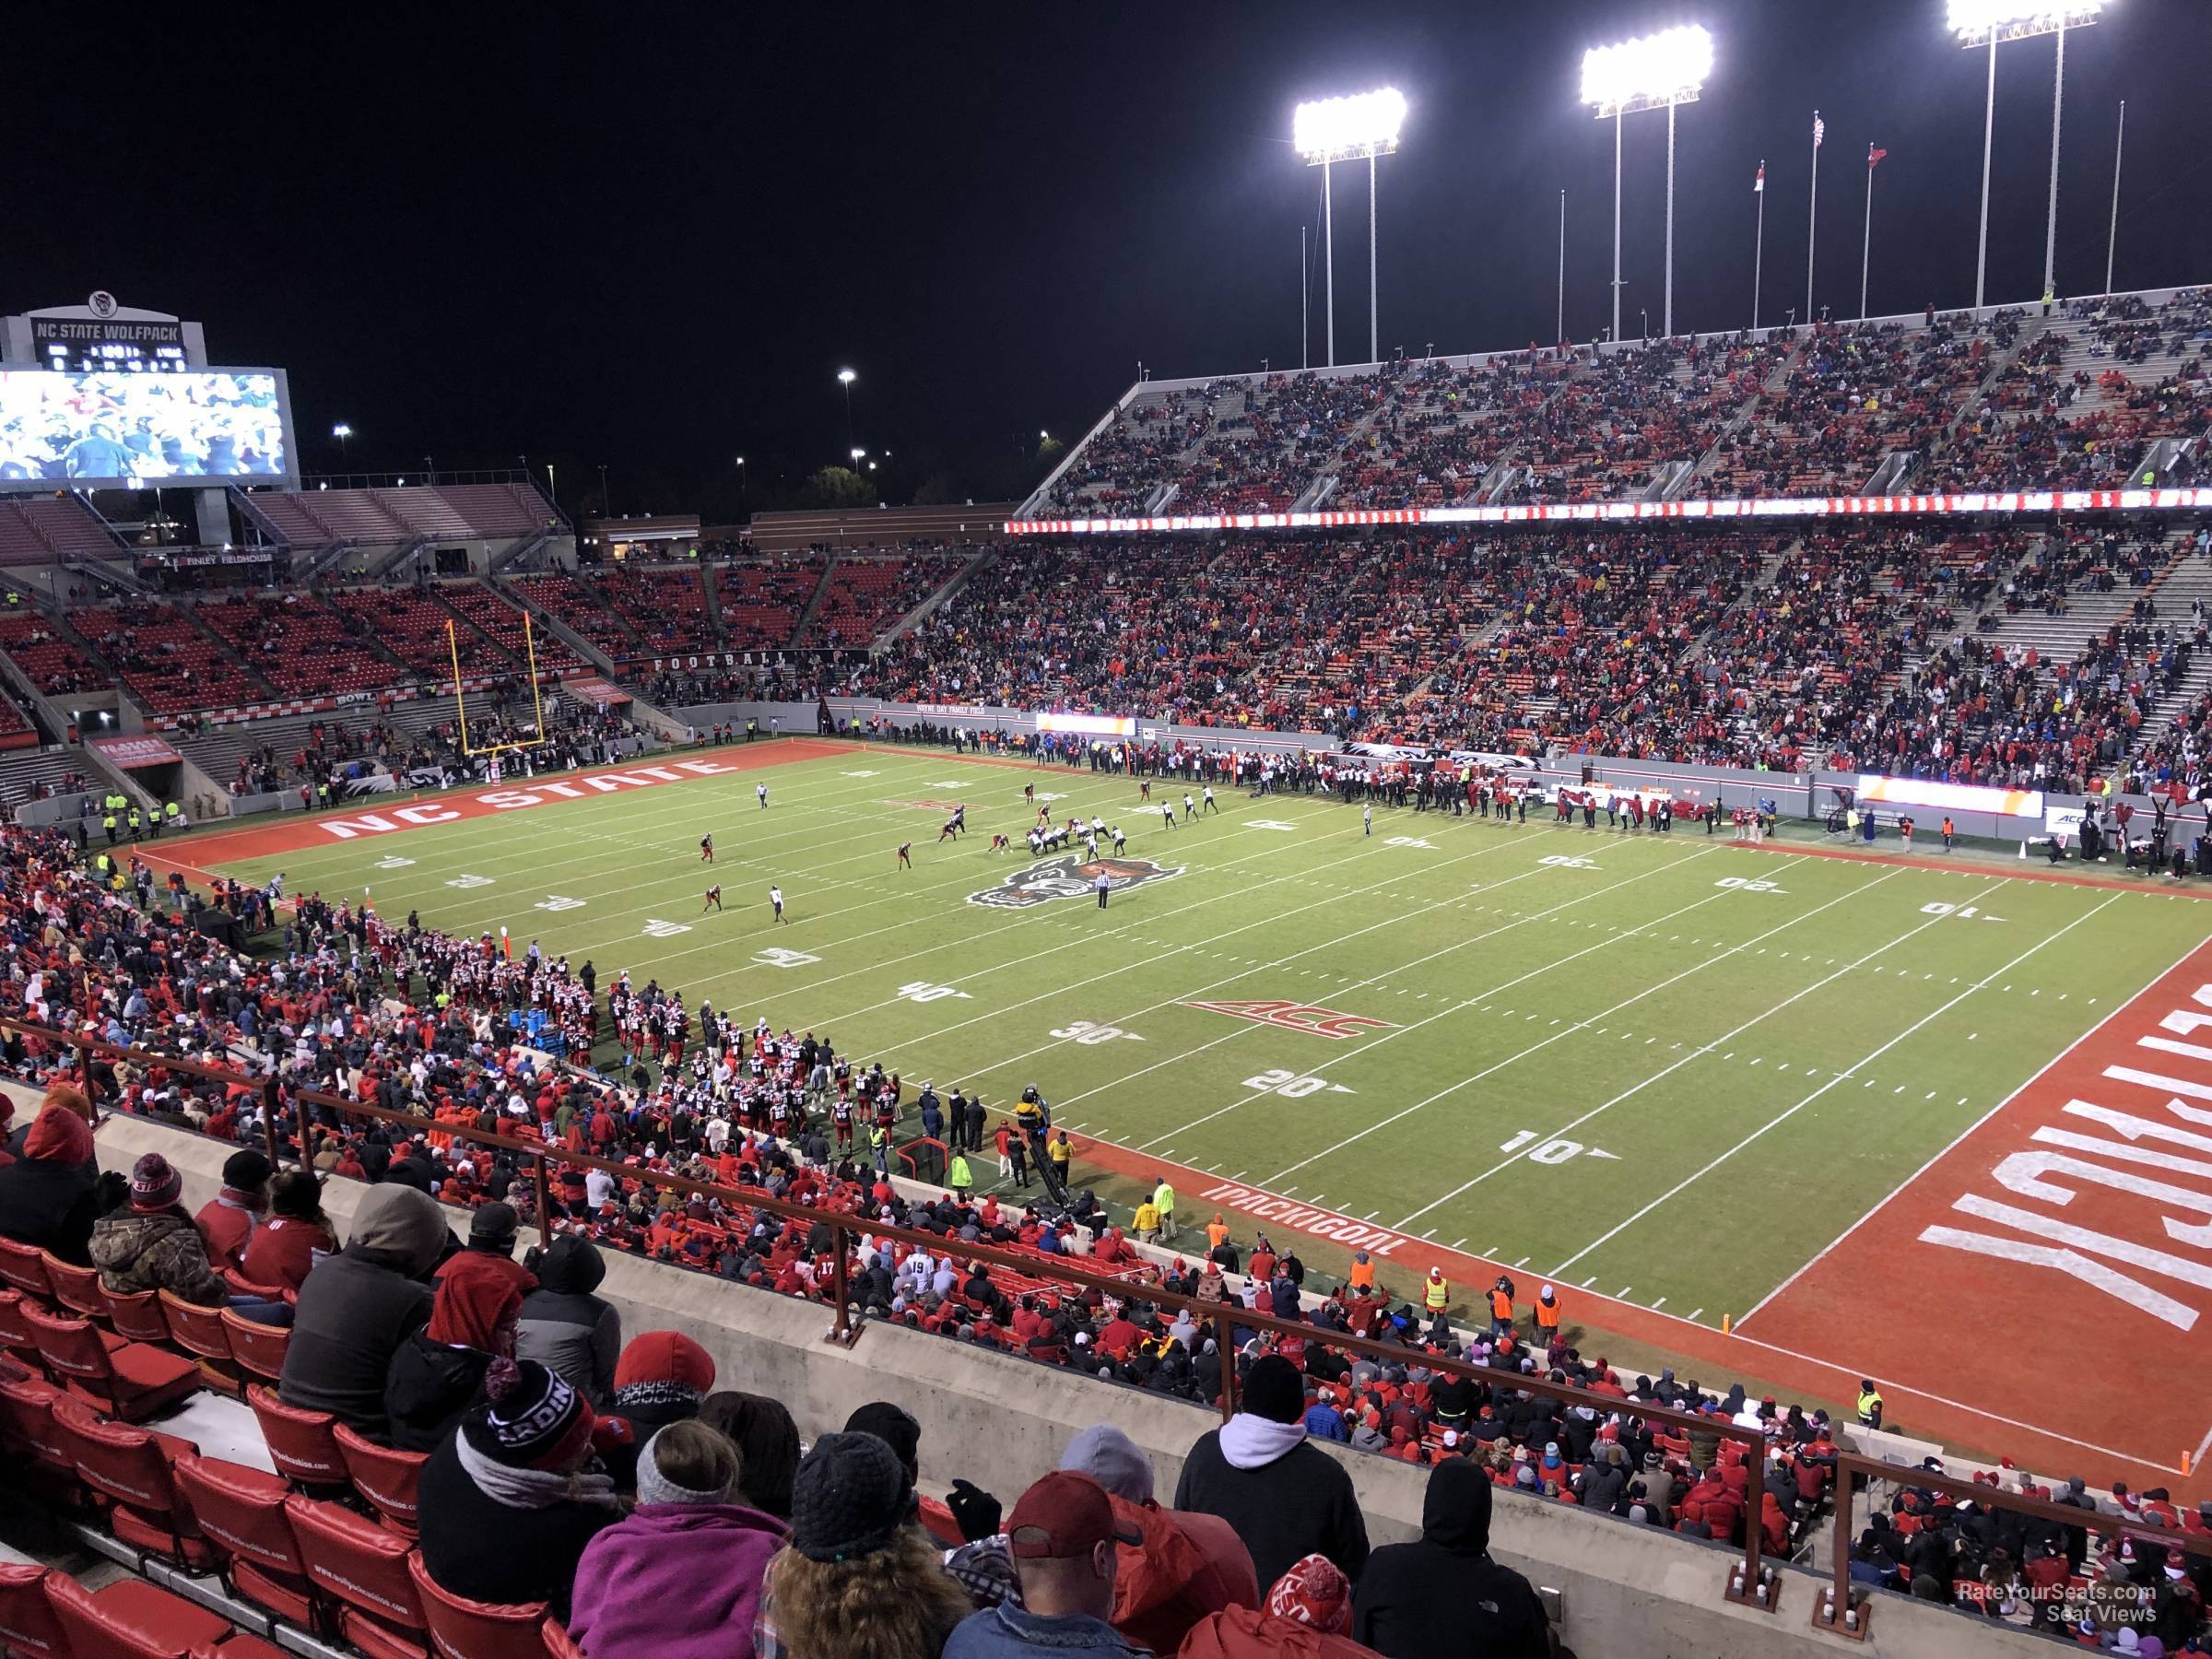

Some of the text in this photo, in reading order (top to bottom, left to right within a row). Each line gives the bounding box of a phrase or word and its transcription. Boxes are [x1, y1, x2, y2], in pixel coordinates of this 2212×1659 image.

[37, 324, 178, 341] NC STATE WOLFPACK
[187, 555, 215, 565] FINLEY
[222, 554, 273, 564] FIELDHOUSE
[654, 651, 786, 671] FOOTBALL
[336, 693, 376, 705] BOWL
[917, 704, 985, 715] WAYNE DAY FAMILY FIELD
[318, 759, 738, 840] NC STATE
[1537, 855, 1594, 869] 30
[1714, 877, 1779, 891] 20
[1920, 902, 1979, 919] 10
[750, 947, 824, 968] 50
[897, 981, 956, 1003] 40
[1174, 1000, 1406, 1039] ACC
[1049, 1020, 1123, 1045] 30
[1241, 1069, 1328, 1098] 20
[1499, 1130, 1584, 1165] 10
[822, 1262, 834, 1275] 17
[913, 1261, 924, 1274] 19
